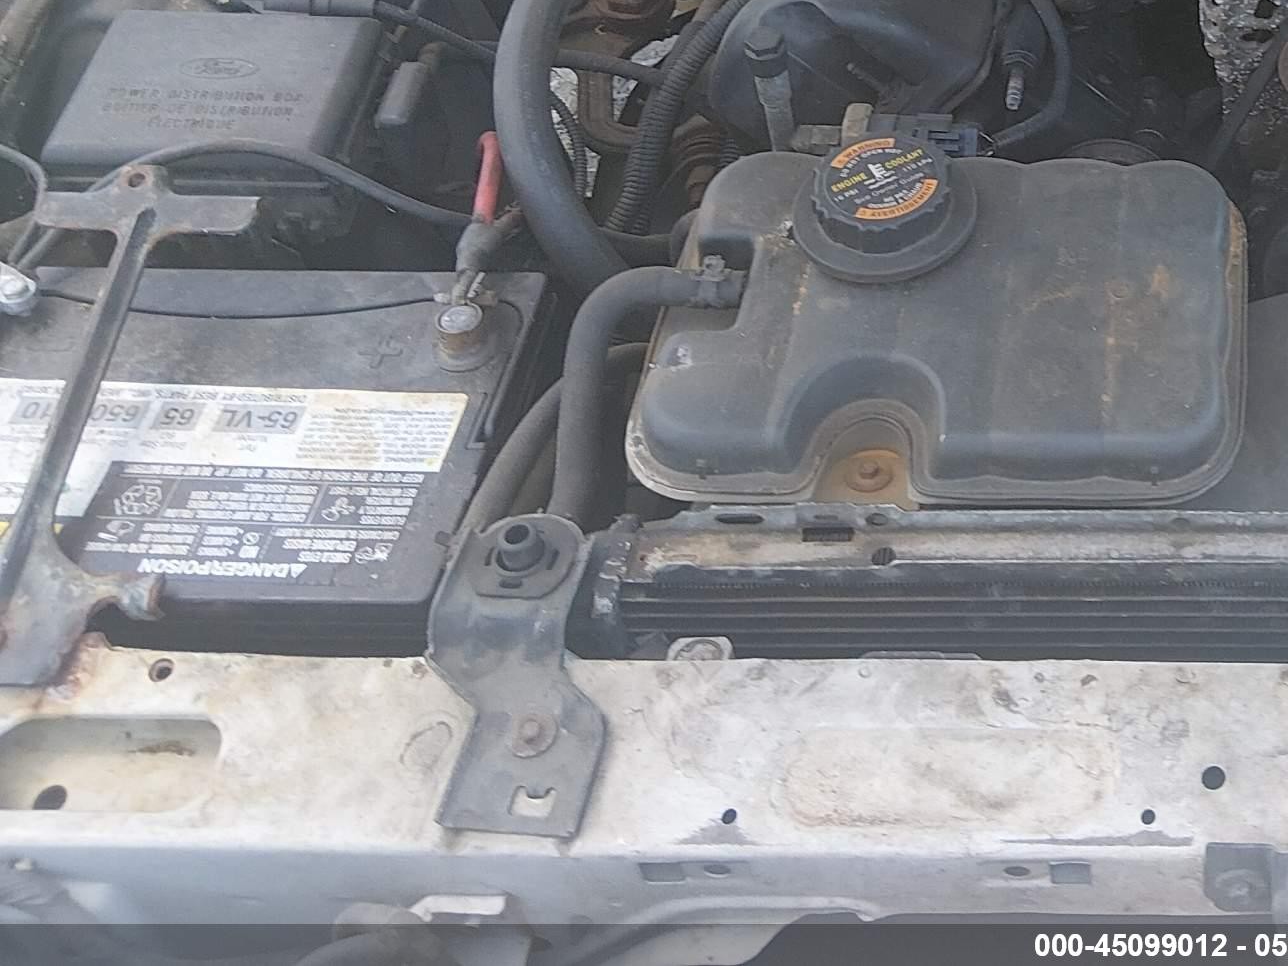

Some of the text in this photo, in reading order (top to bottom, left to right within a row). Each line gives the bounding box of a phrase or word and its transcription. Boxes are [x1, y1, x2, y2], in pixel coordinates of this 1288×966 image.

[168, 89, 264, 102] DISTRIBUTION
[831, 149, 924, 192] ENGINE COOLANT
[160, 407, 195, 426] 65
[222, 409, 298, 429] 65-VL
